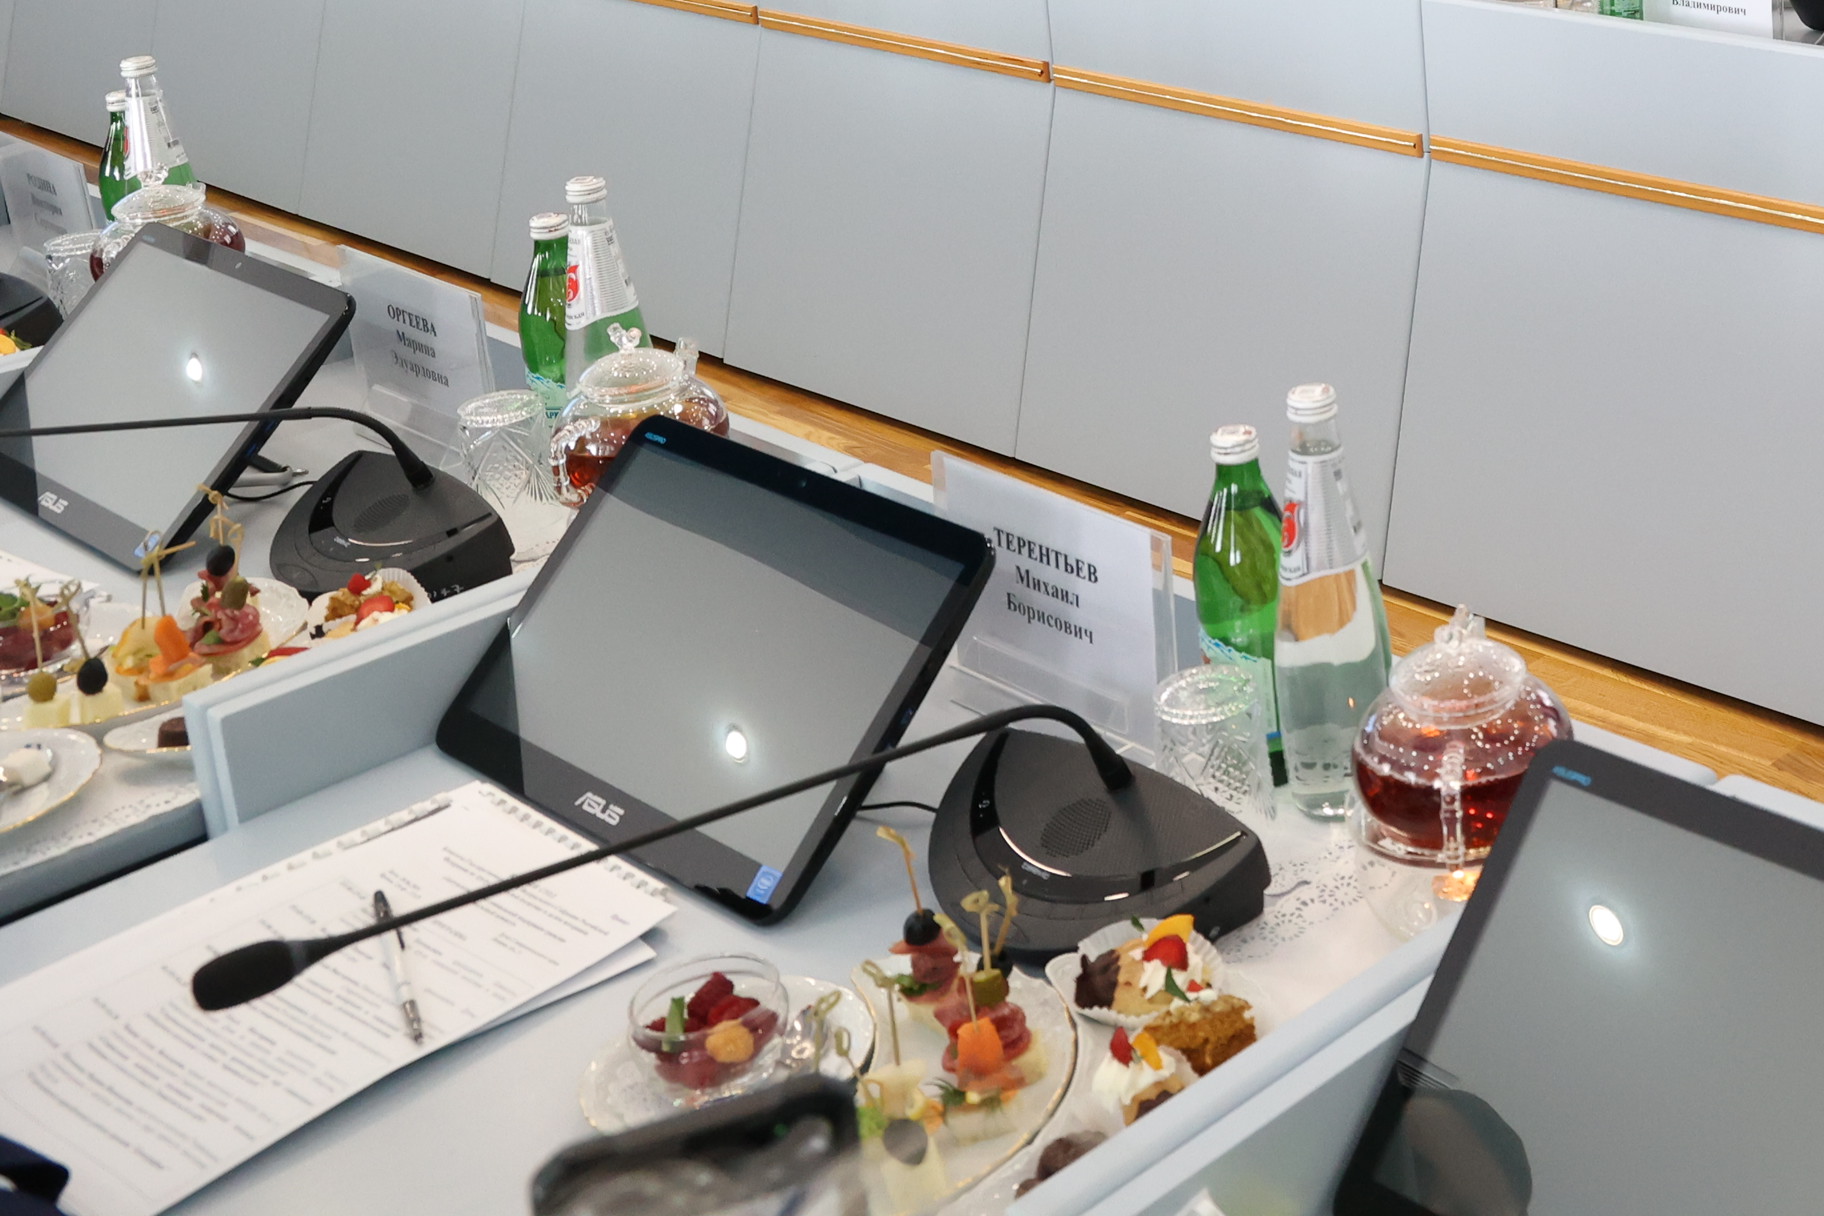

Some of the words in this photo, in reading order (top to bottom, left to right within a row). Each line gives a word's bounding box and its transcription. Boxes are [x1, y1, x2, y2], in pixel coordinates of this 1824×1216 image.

[387, 304, 437, 337] ОРГЕЕВА
[396, 329, 436, 358] Марина
[38, 491, 69, 514] ASUS
[993, 526, 1099, 584] ТЕРЕНТЬЕВ
[1015, 564, 1080, 609] Михаил
[1006, 591, 1094, 645] Борисович
[573, 791, 625, 826] ASUS
